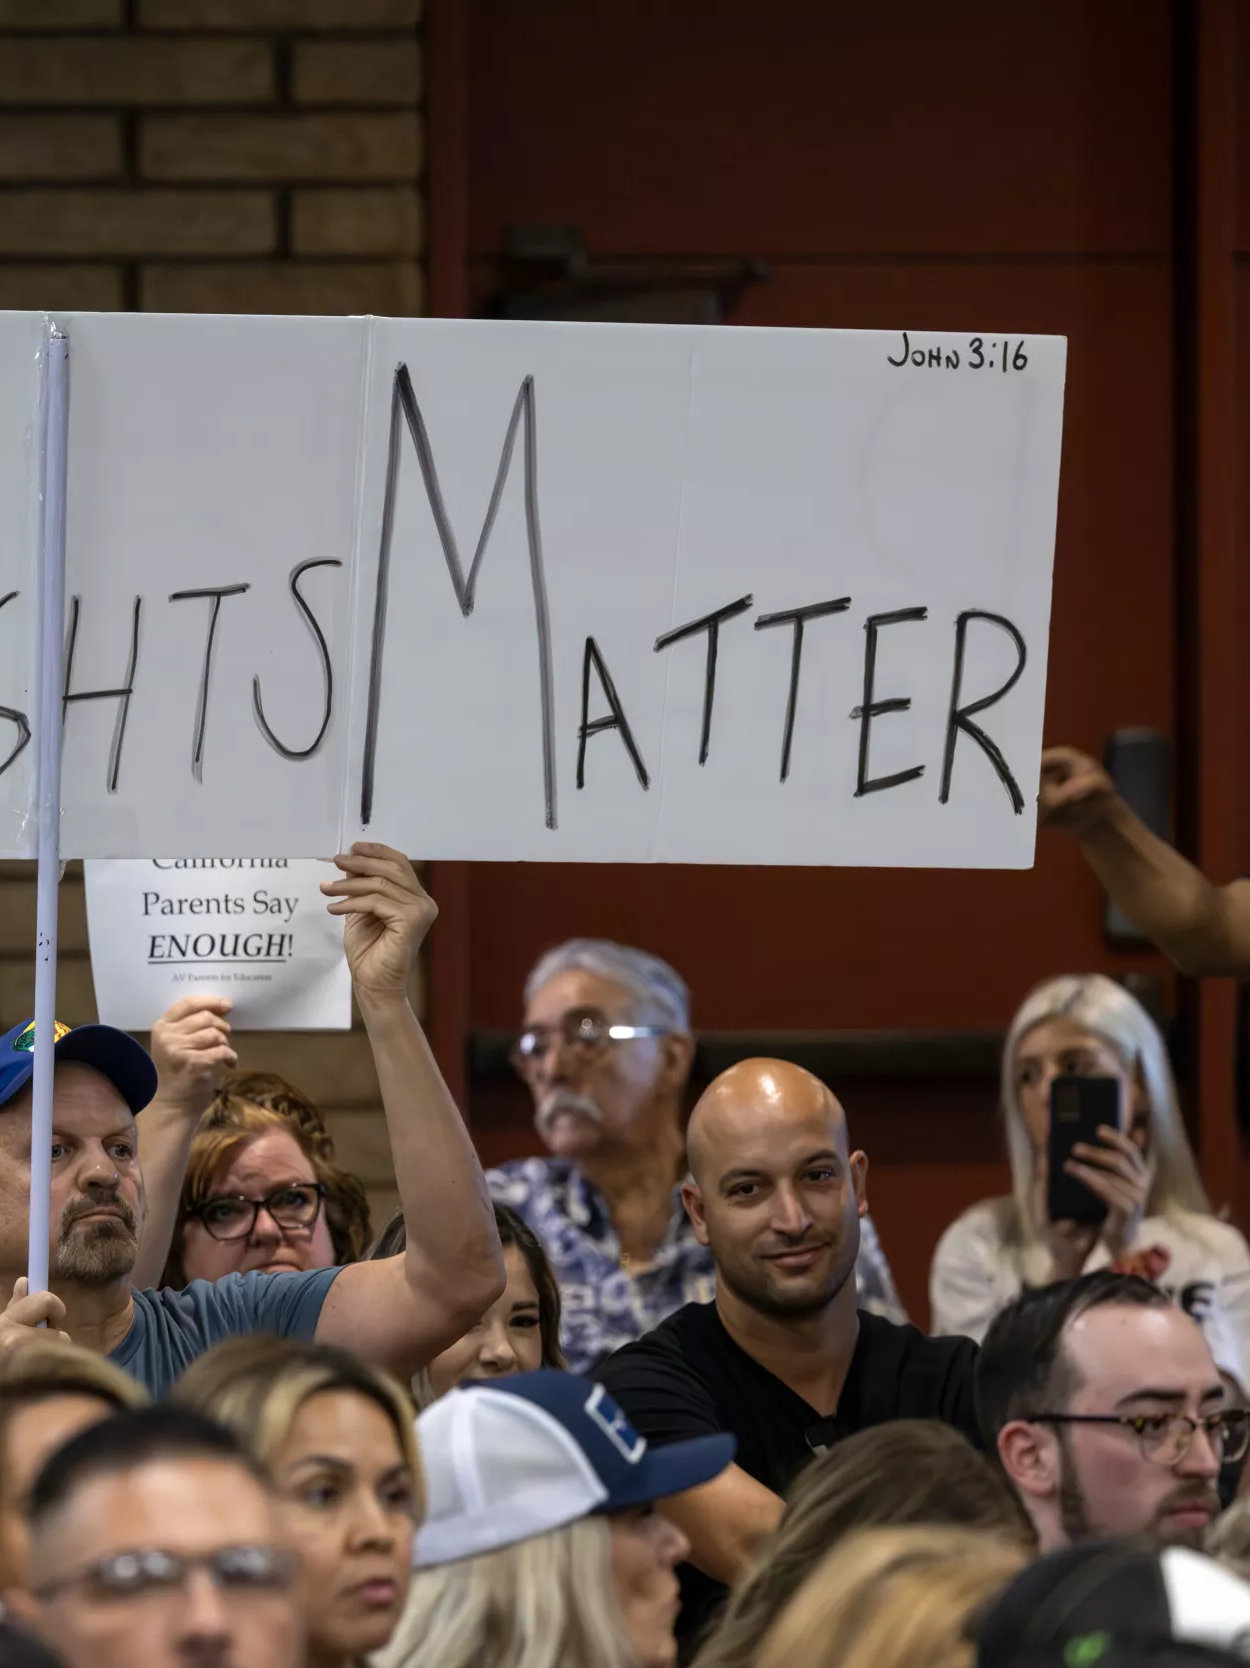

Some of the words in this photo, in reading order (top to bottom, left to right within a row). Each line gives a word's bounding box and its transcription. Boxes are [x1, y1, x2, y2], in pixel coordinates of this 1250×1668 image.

[886, 331, 961, 370] JOHN
[967, 336, 1029, 374] 3:16
[358, 361, 1029, 832] MATTER
[142, 891, 246, 917] Parents
[252, 889, 300, 924] Say
[147, 933, 294, 960] ENOUGH!
